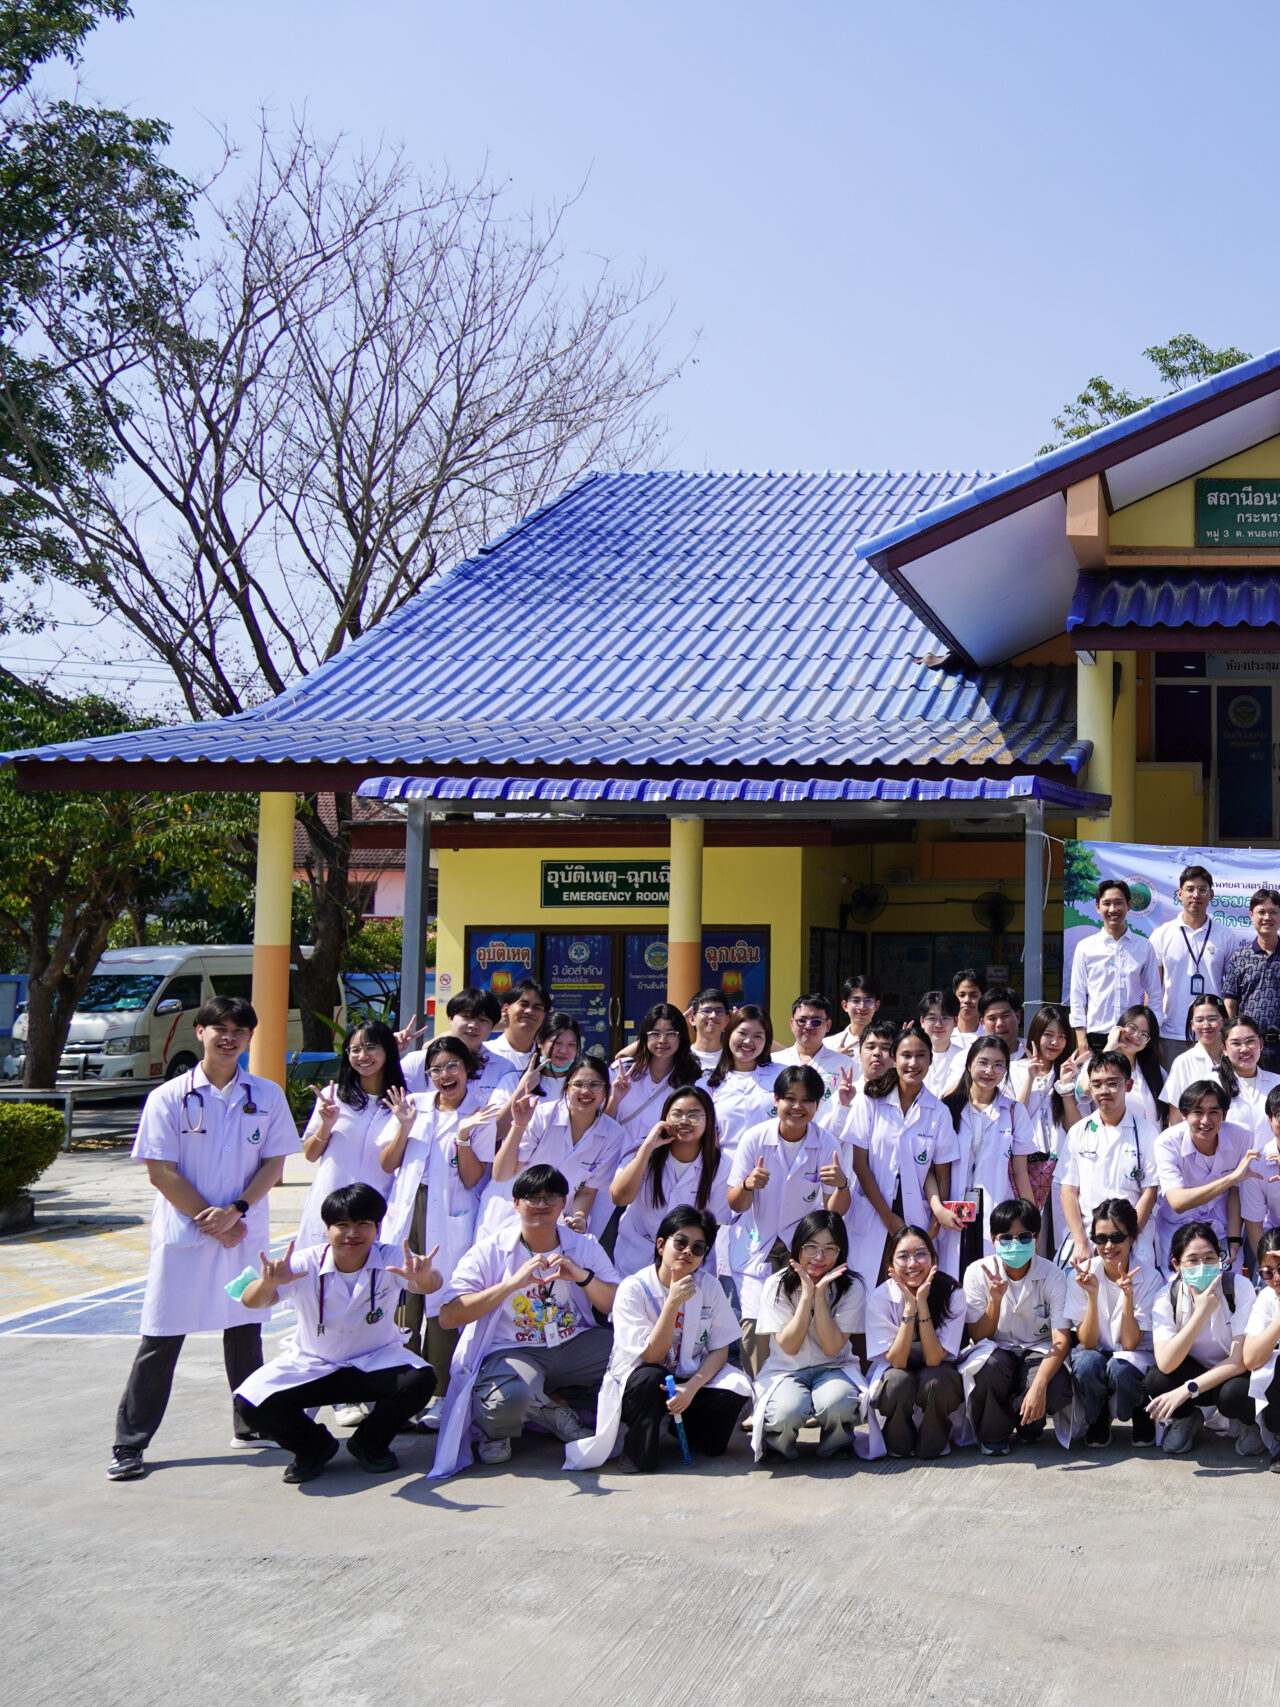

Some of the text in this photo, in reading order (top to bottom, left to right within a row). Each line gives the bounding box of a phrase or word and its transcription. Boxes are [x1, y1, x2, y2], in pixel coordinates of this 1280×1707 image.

[1223, 529, 1230, 538] 3
[546, 865, 670, 889] อุบัติเหตุ-ฉุกเฉิ
[562, 891, 669, 902] EMERGENCY ROOM
[475, 941, 532, 969] อุบัติเหตุ
[704, 940, 760, 971] ฉุกเฉิน
[552, 965, 559, 976] 3
